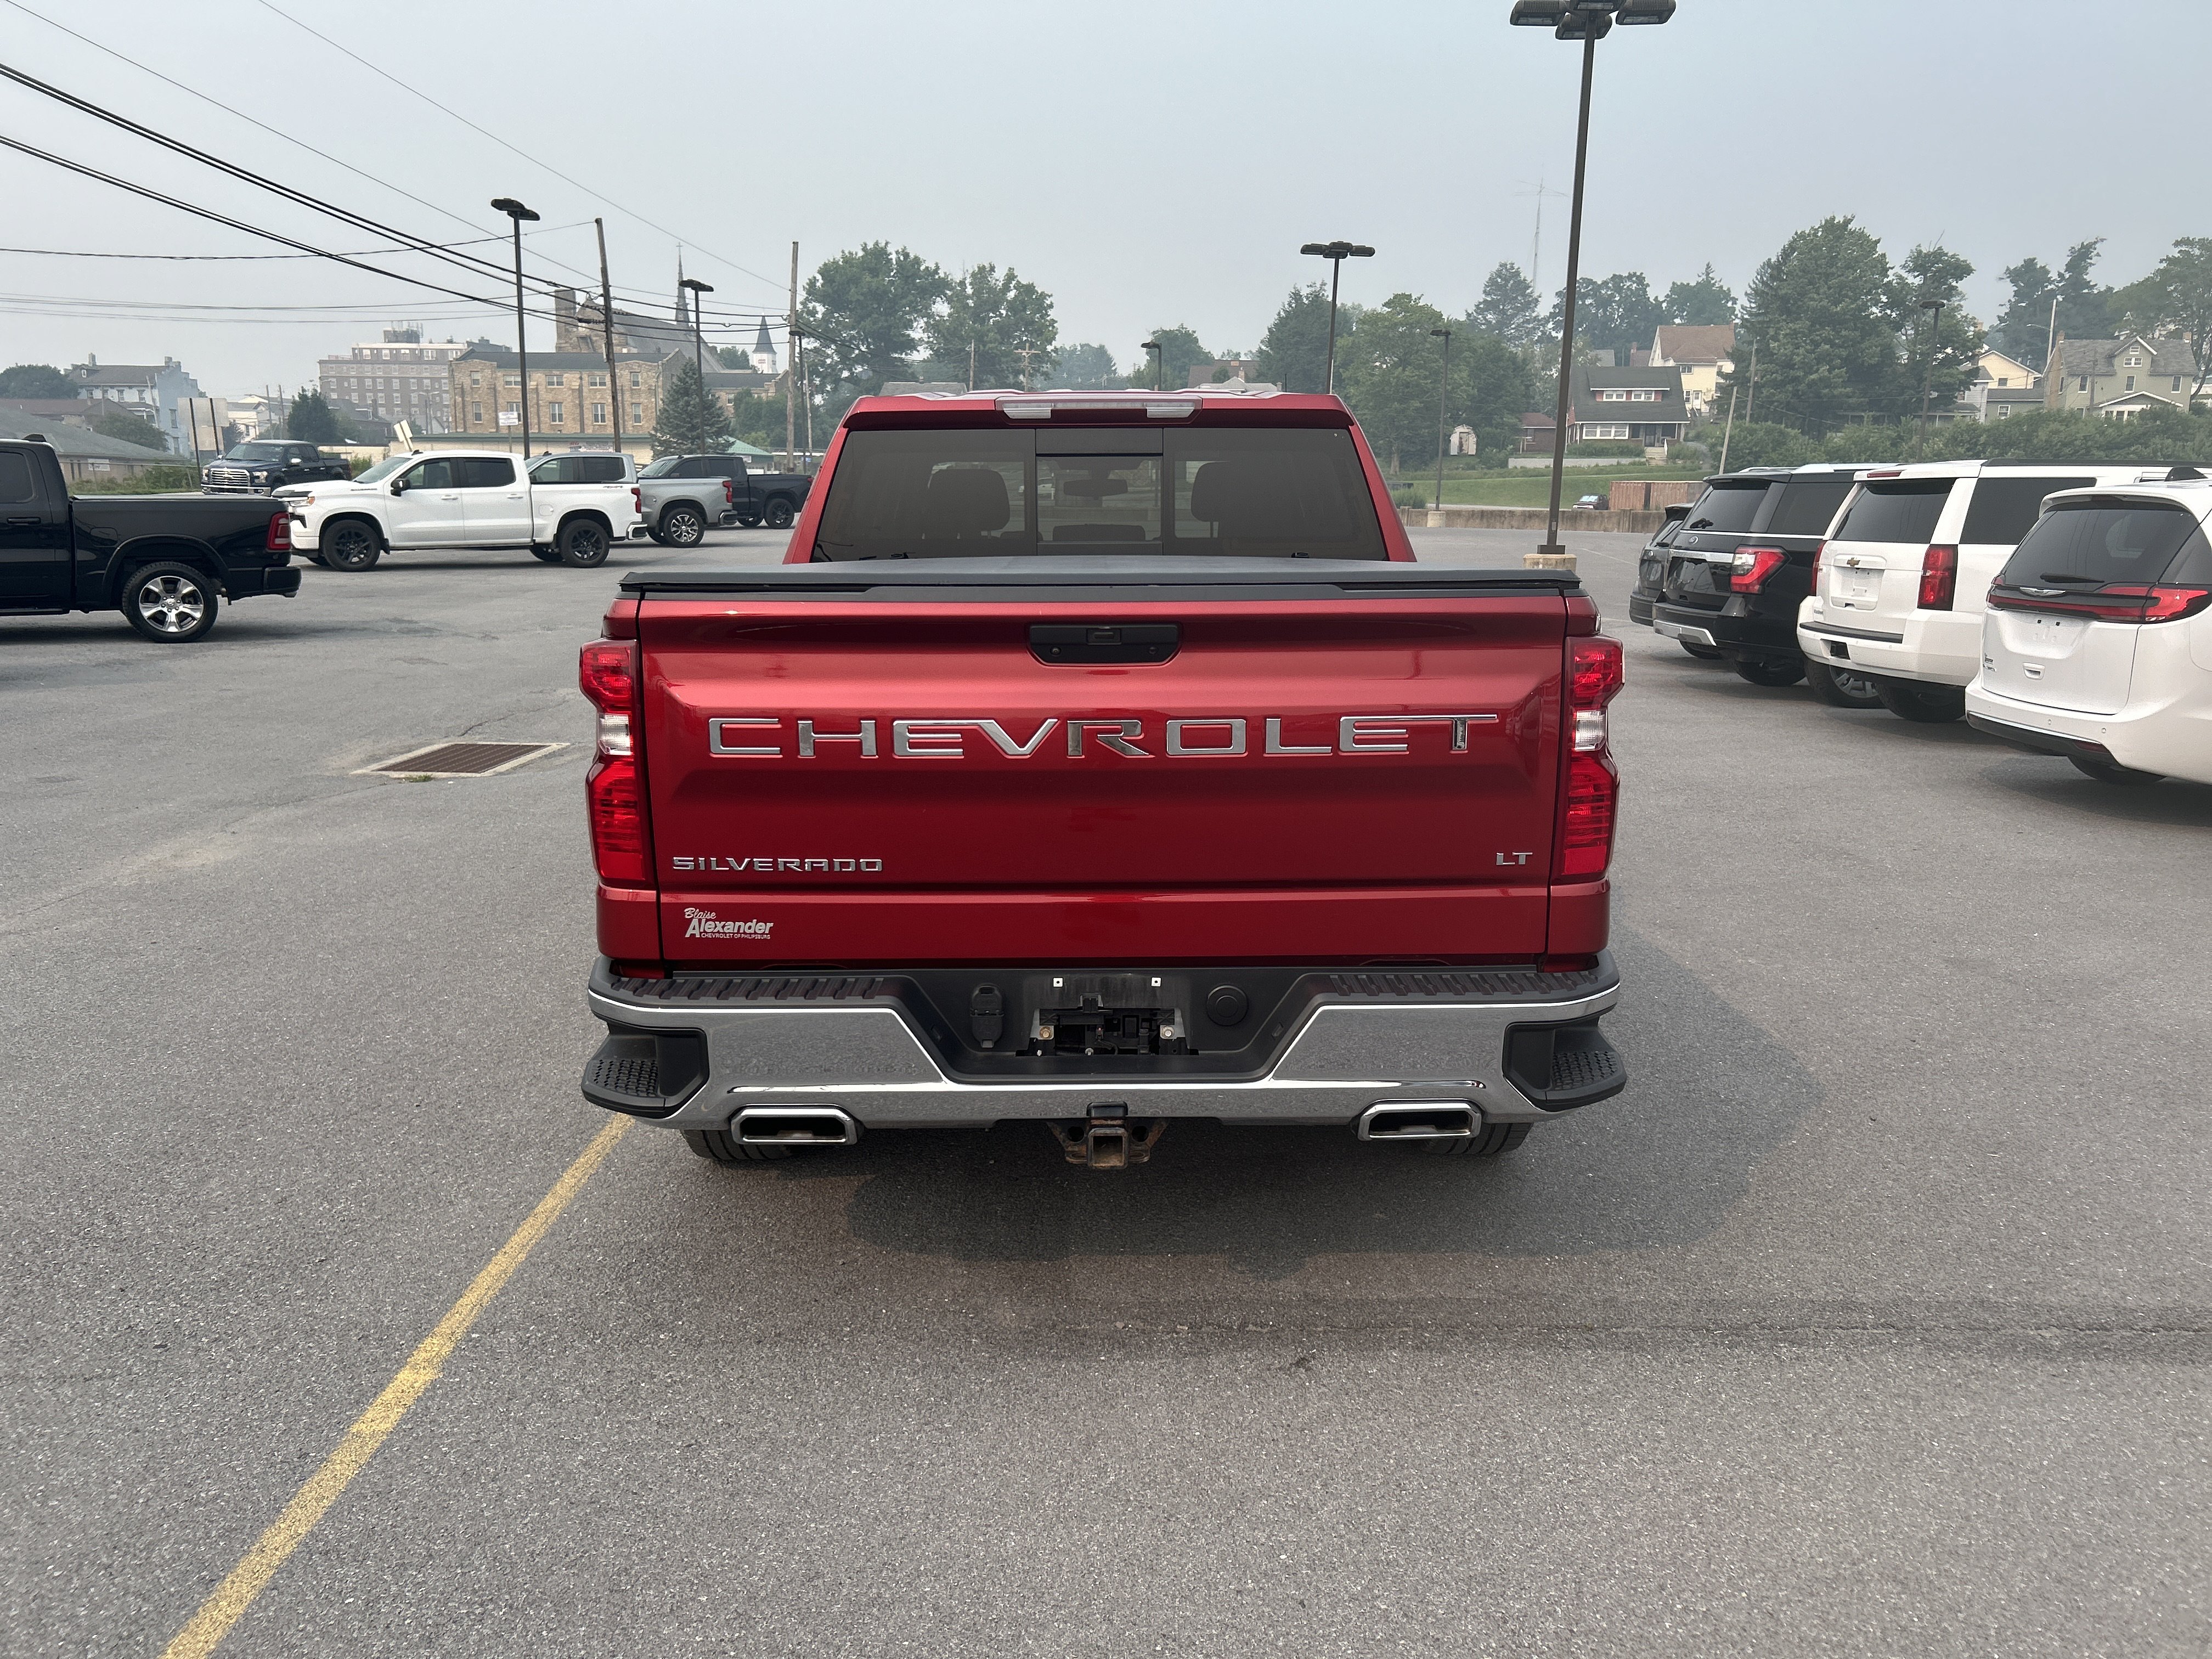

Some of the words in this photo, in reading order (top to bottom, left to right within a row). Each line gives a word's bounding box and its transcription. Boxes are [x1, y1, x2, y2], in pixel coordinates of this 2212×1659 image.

[709, 714, 1497, 757] CHEVROLET
[673, 857, 883, 871] SILVERADO
[1496, 852, 1533, 865] LT
[684, 907, 716, 919] Blaise
[685, 918, 774, 938] Alexander
